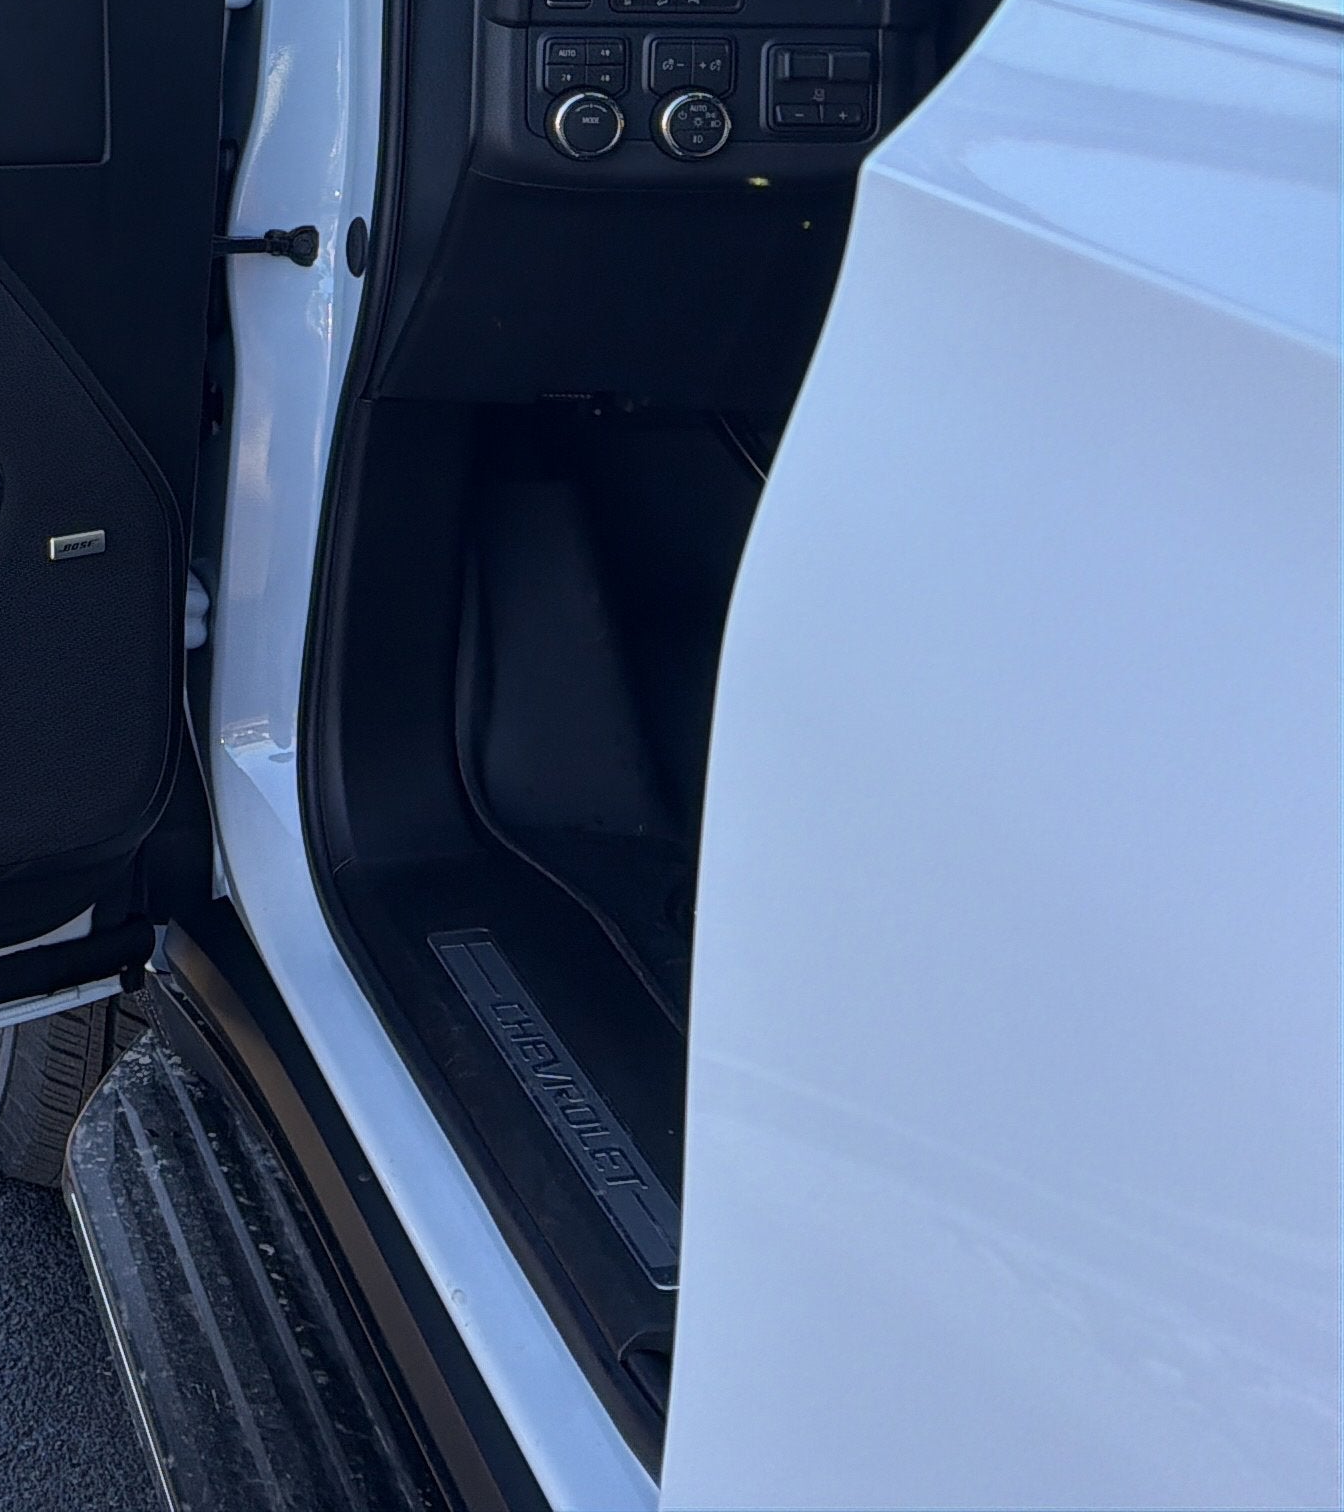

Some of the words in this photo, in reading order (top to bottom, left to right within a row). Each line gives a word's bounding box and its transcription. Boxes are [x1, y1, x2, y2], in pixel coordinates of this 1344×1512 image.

[558, 49, 577, 57] AUTO
[690, 104, 708, 112] AUTO
[582, 116, 599, 124] MODE
[490, 1003, 648, 1190] CHEVROLET
